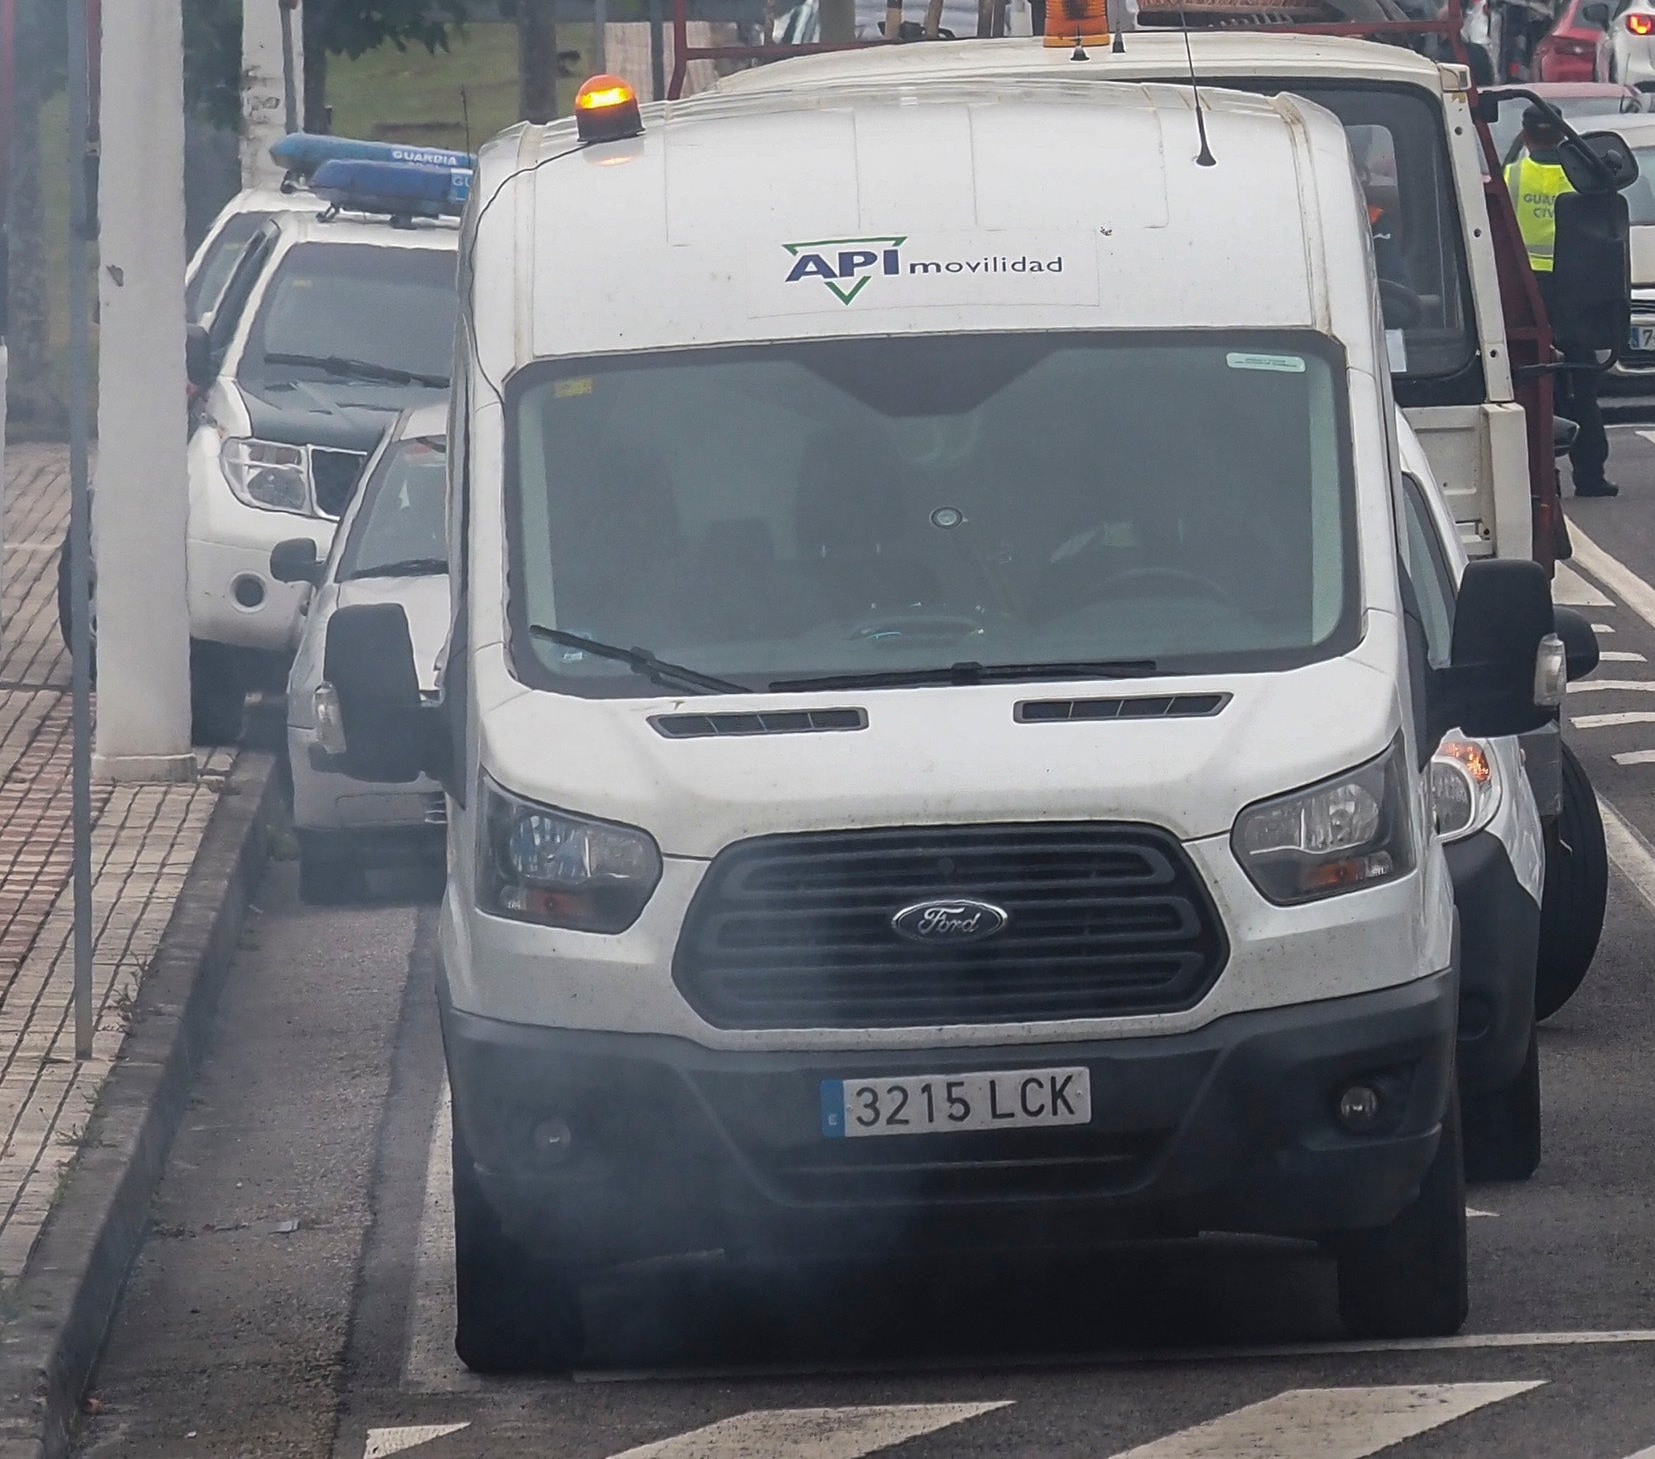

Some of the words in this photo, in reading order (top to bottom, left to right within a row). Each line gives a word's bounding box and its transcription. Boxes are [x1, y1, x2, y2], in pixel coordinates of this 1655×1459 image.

[392, 150, 458, 166] GUARDIA
[784, 249, 900, 283] API
[909, 256, 1064, 275] movilidad
[918, 906, 981, 935] Ford
[855, 1081, 971, 1128] 3215
[988, 1074, 1075, 1120] LCK
